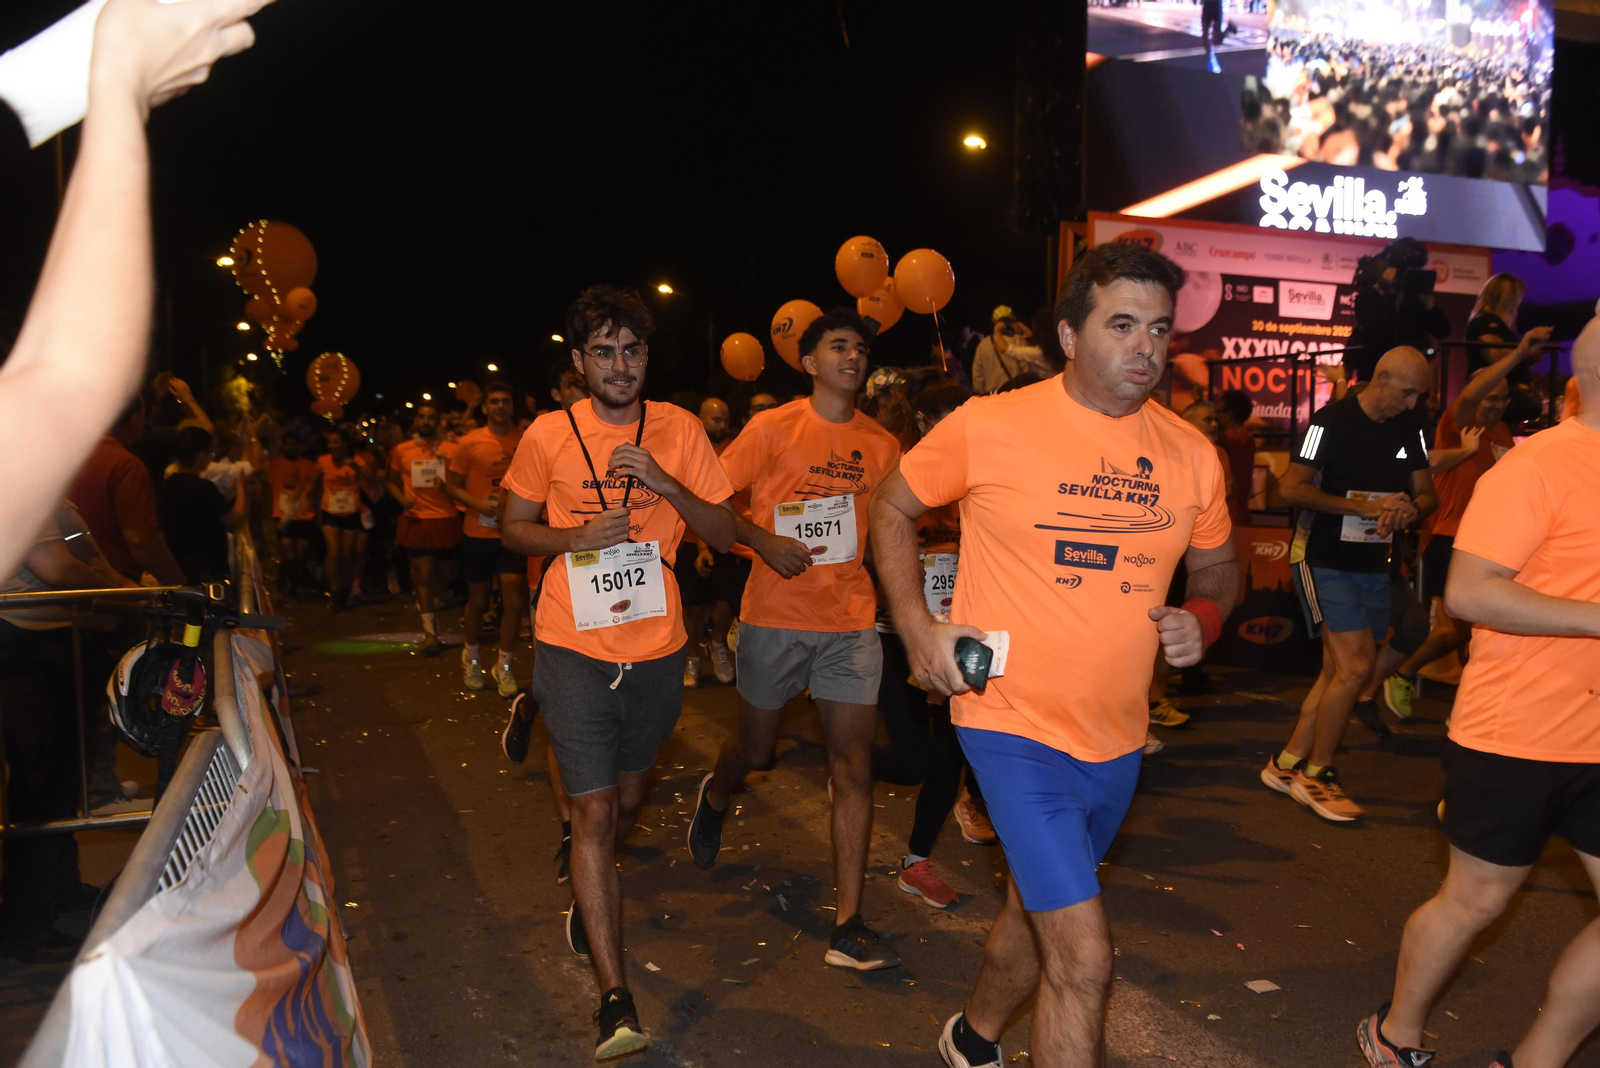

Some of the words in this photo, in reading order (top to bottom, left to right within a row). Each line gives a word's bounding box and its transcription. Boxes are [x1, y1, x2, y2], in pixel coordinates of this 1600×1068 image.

[1175, 242, 1197, 252] ABC
[1208, 246, 1256, 260] Cruzcampo
[1252, 320, 1265, 331] 30
[1265, 321, 1278, 332] de
[1278, 322, 1332, 336] septiembre
[1221, 336, 1290, 363] XXXIV
[809, 466, 841, 478] SEVILLA
[827, 461, 865, 473] NOCTURNA
[1091, 474, 1160, 493] NOCTURNA
[1057, 483, 1122, 502] SEVILLA
[795, 519, 841, 539] 15671
[591, 567, 646, 594] 15012
[931, 573, 957, 590] 295
